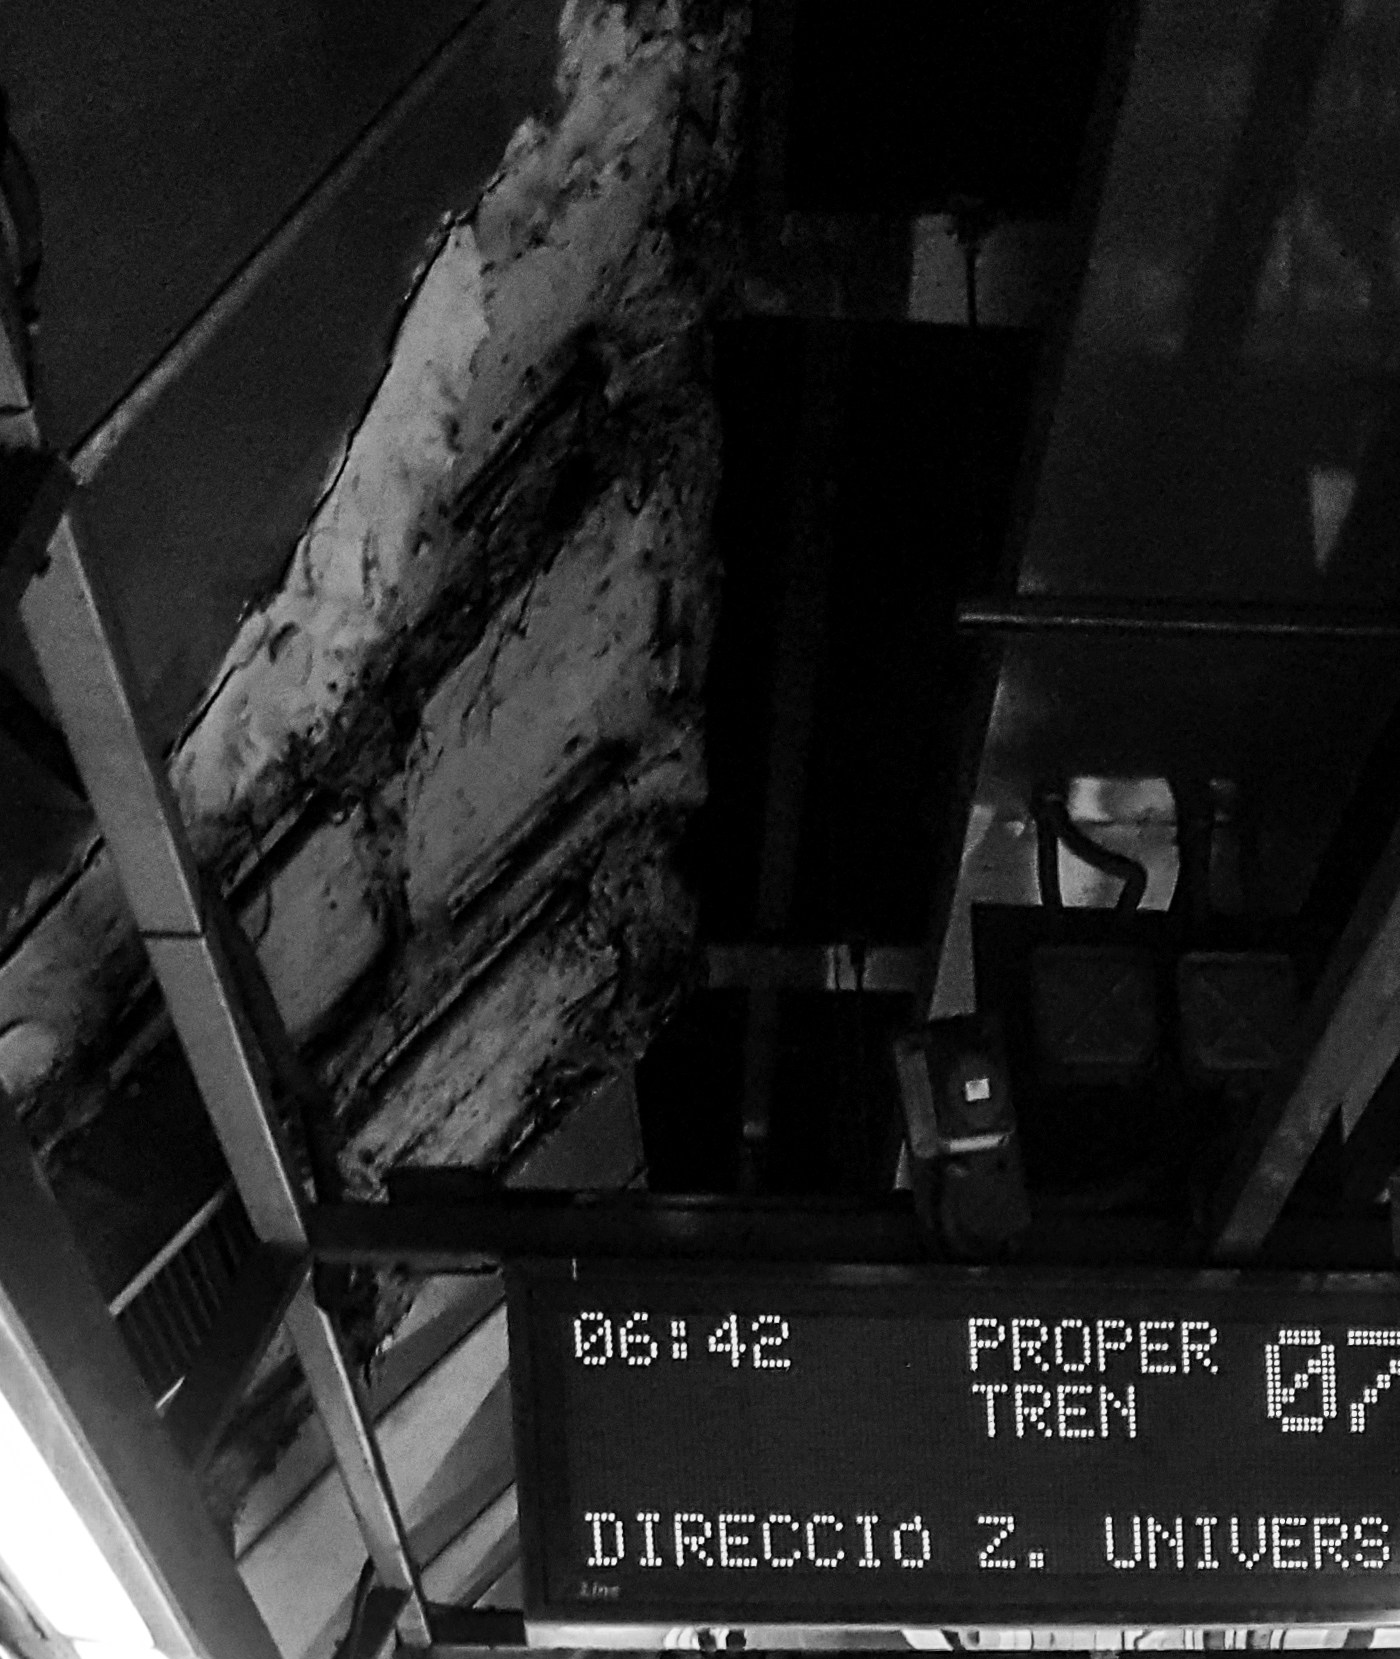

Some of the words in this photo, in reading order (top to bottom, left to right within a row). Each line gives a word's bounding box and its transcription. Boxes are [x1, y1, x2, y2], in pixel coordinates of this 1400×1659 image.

[574, 1312, 791, 1367] 06:42
[968, 1317, 1219, 1373] PROPER
[971, 1383, 1137, 1438] TREN
[977, 1515, 1044, 1569] Z.
